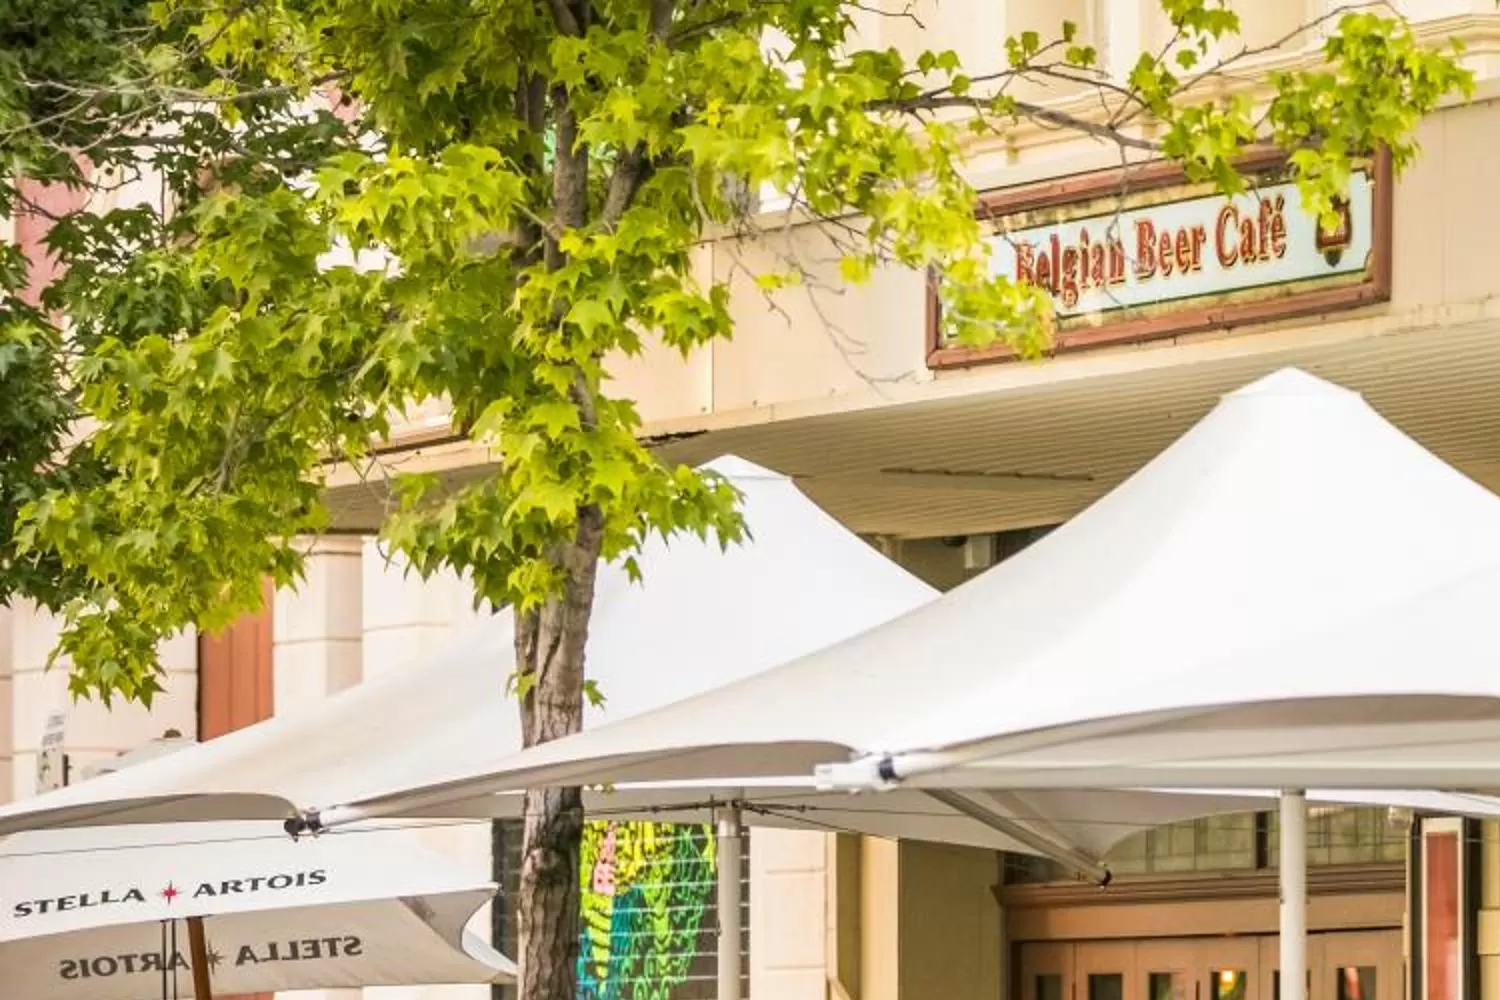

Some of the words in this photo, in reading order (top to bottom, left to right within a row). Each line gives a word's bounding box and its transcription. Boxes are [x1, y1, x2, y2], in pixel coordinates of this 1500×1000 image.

[1015, 227, 1126, 308] Belgian
[1134, 211, 1207, 281] Beer
[1216, 194, 1288, 268] Café
[13, 889, 146, 918] STELLA
[192, 869, 328, 899] ARTOIS
